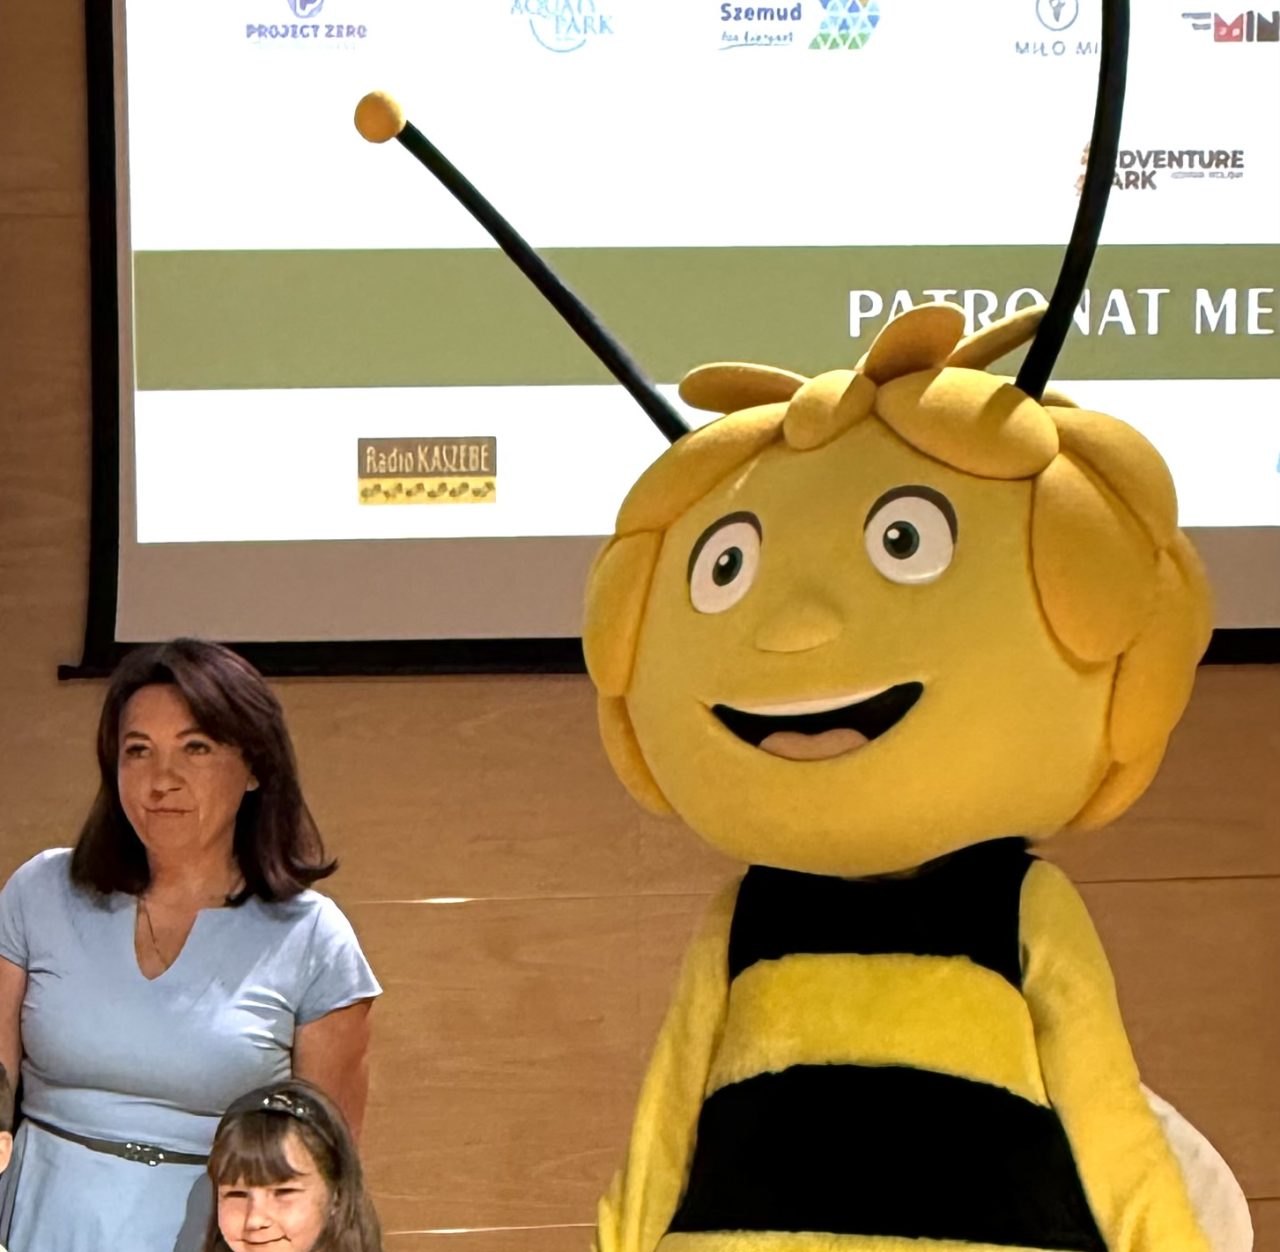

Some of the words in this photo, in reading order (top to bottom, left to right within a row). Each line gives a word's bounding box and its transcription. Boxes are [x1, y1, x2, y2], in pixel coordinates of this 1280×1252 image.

[720, 2, 803, 21] Szemud
[246, 23, 320, 39] PROJECT
[324, 23, 368, 38] ZERO
[1114, 149, 1245, 169] DVENTURE
[1112, 170, 1158, 190] ARK
[1195, 286, 1276, 336] ME
[366, 445, 414, 473] Radio
